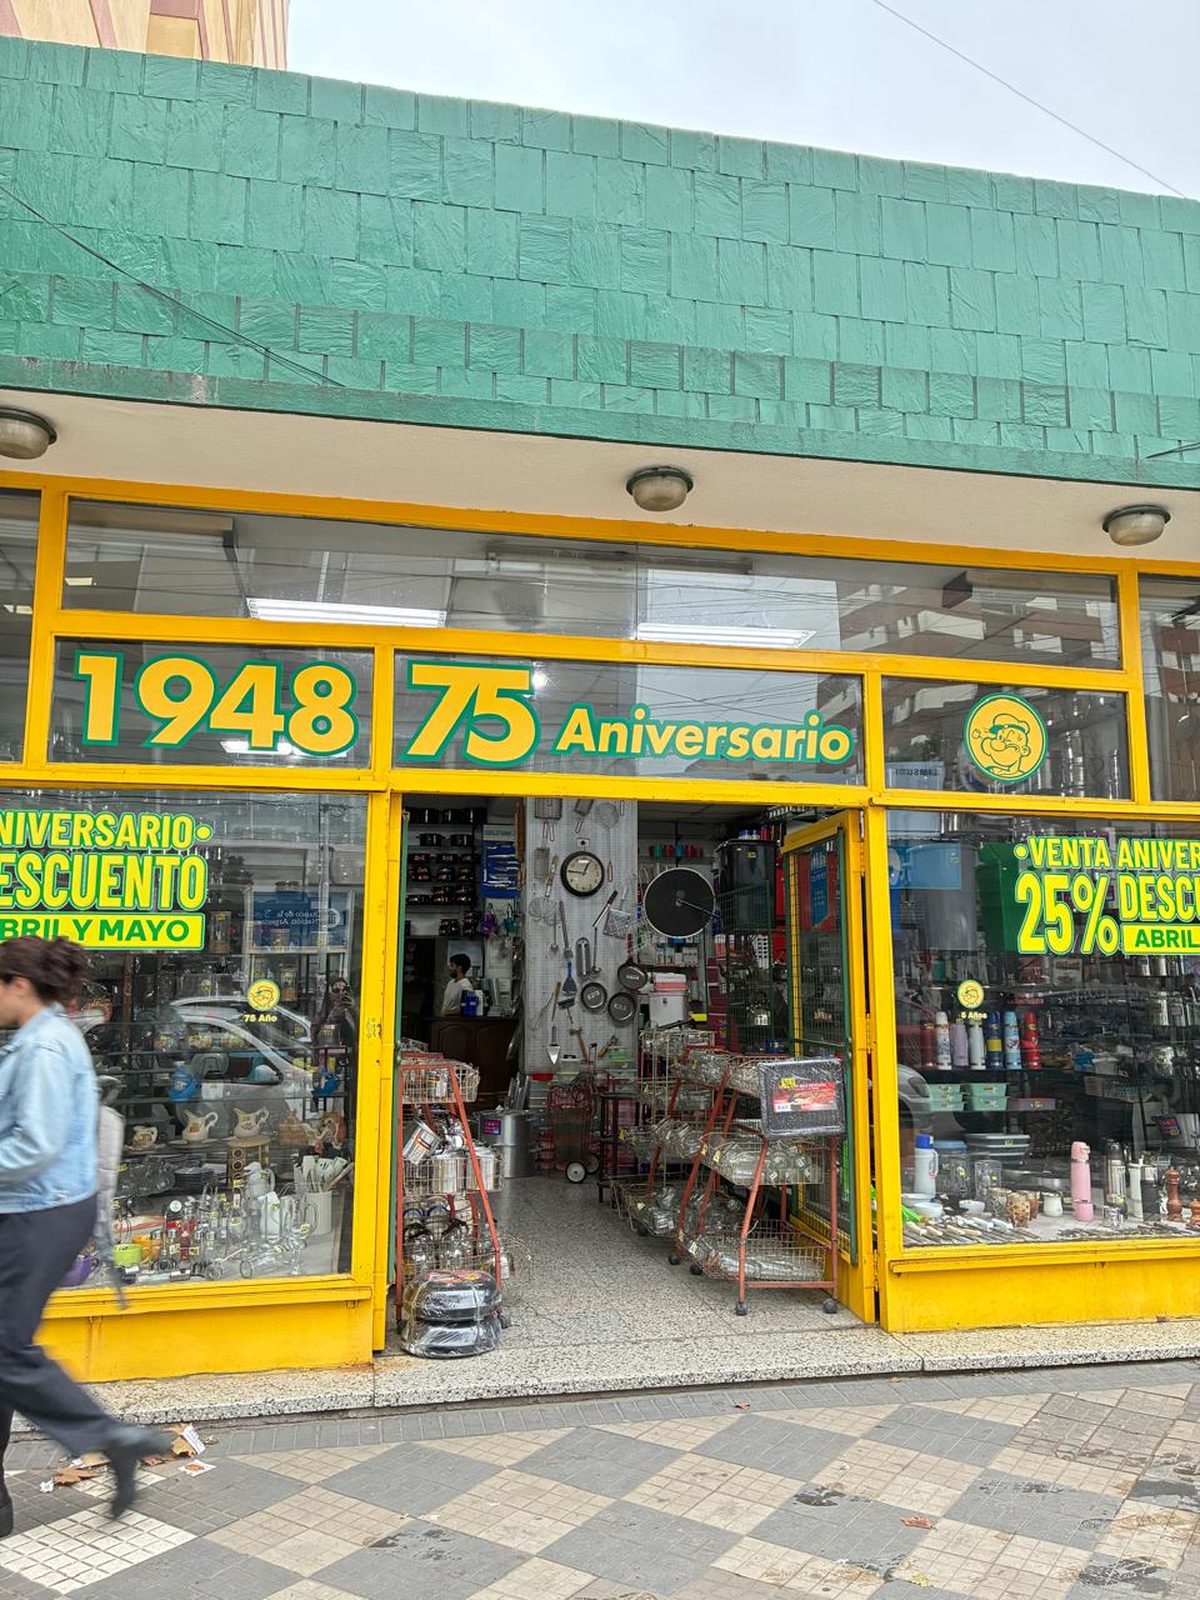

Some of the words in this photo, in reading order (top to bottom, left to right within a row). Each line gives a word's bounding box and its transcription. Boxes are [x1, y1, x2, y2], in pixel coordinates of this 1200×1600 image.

[76, 650, 359, 755] 1948
[402, 661, 540, 766] 75
[552, 704, 855, 764] Aniversario
[1028, 836, 1111, 868] VENTA
[1015, 871, 1120, 955] 25%
[0, 918, 66, 940] BRIL
[73, 919, 94, 940] Y
[99, 919, 190, 942] MAYO
[1135, 929, 1200, 948] ABRIL
[244, 1014, 256, 1022] 75
[258, 1014, 278, 1023] Año
